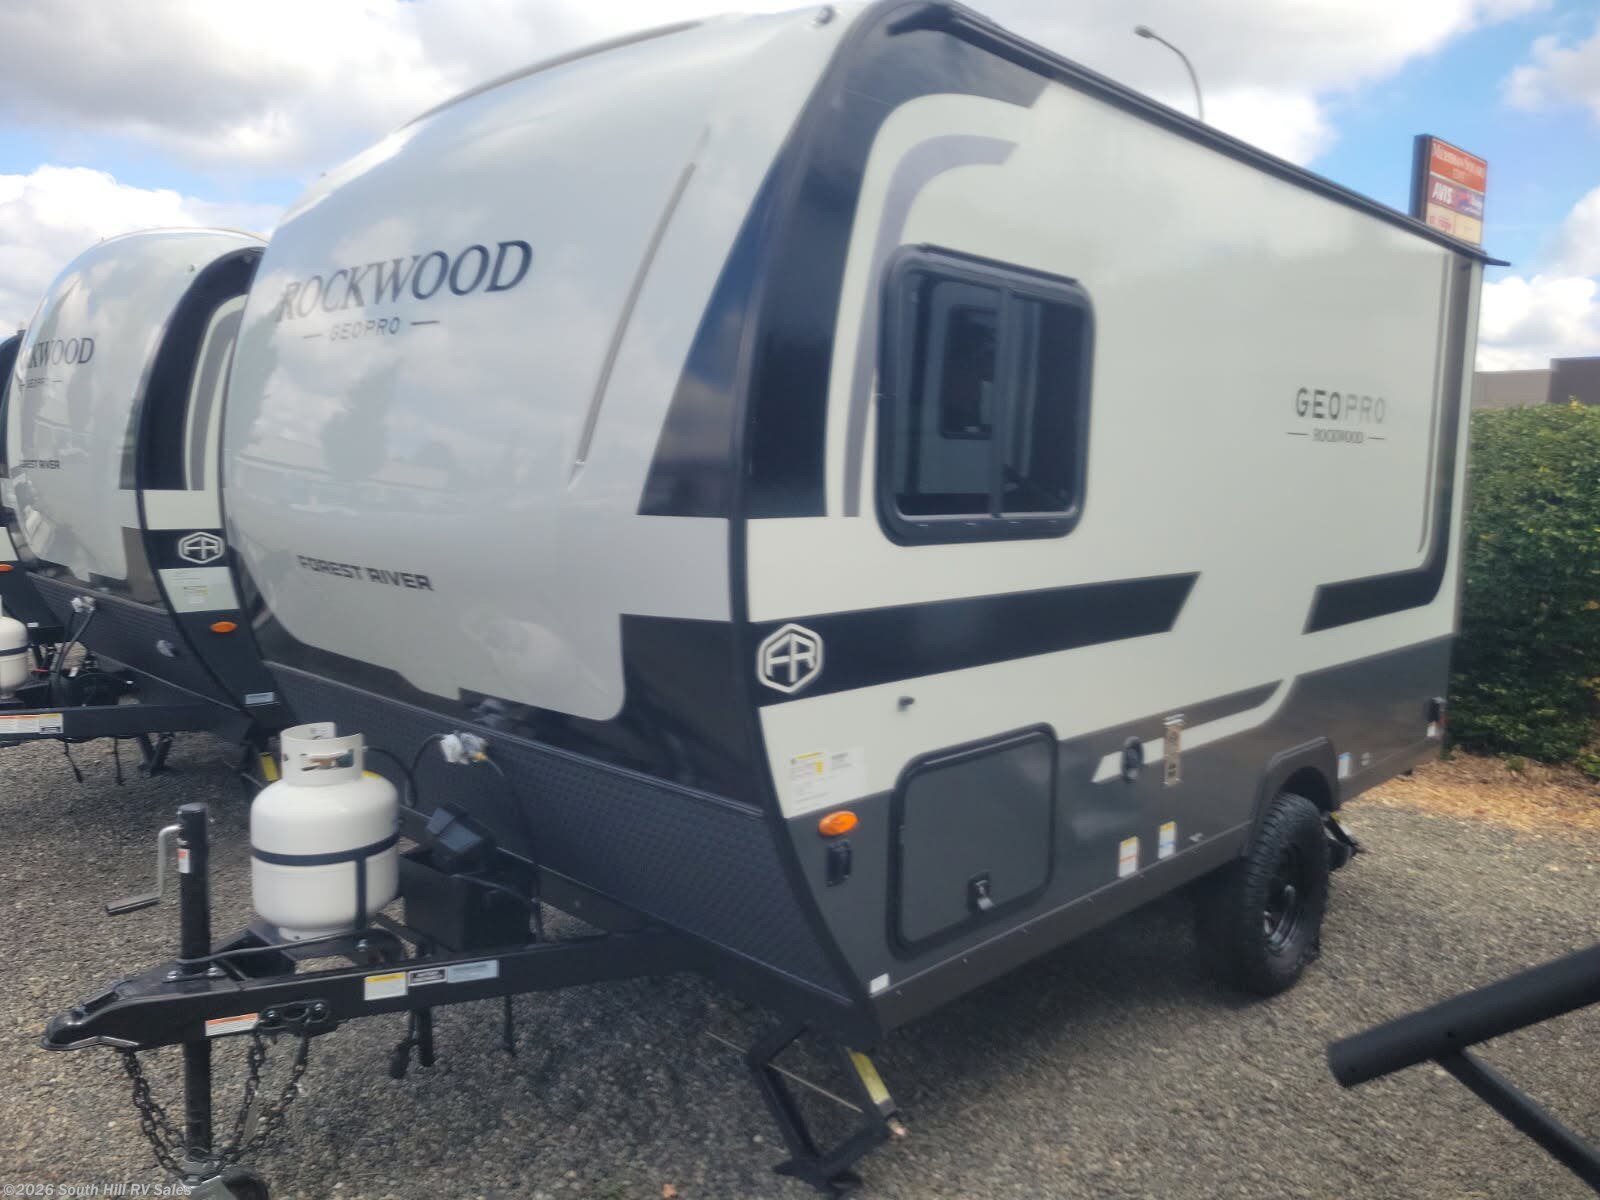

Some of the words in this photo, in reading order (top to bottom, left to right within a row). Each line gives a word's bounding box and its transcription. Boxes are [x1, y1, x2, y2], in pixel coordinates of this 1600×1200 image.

[274, 239, 533, 323] ROCKWOOD
[329, 317, 401, 341] GEOPRO
[27, 337, 95, 368] KWOOD
[1295, 387, 1386, 423] GEOPRO
[297, 555, 363, 580] FOREST
[366, 567, 434, 591] RIVER
